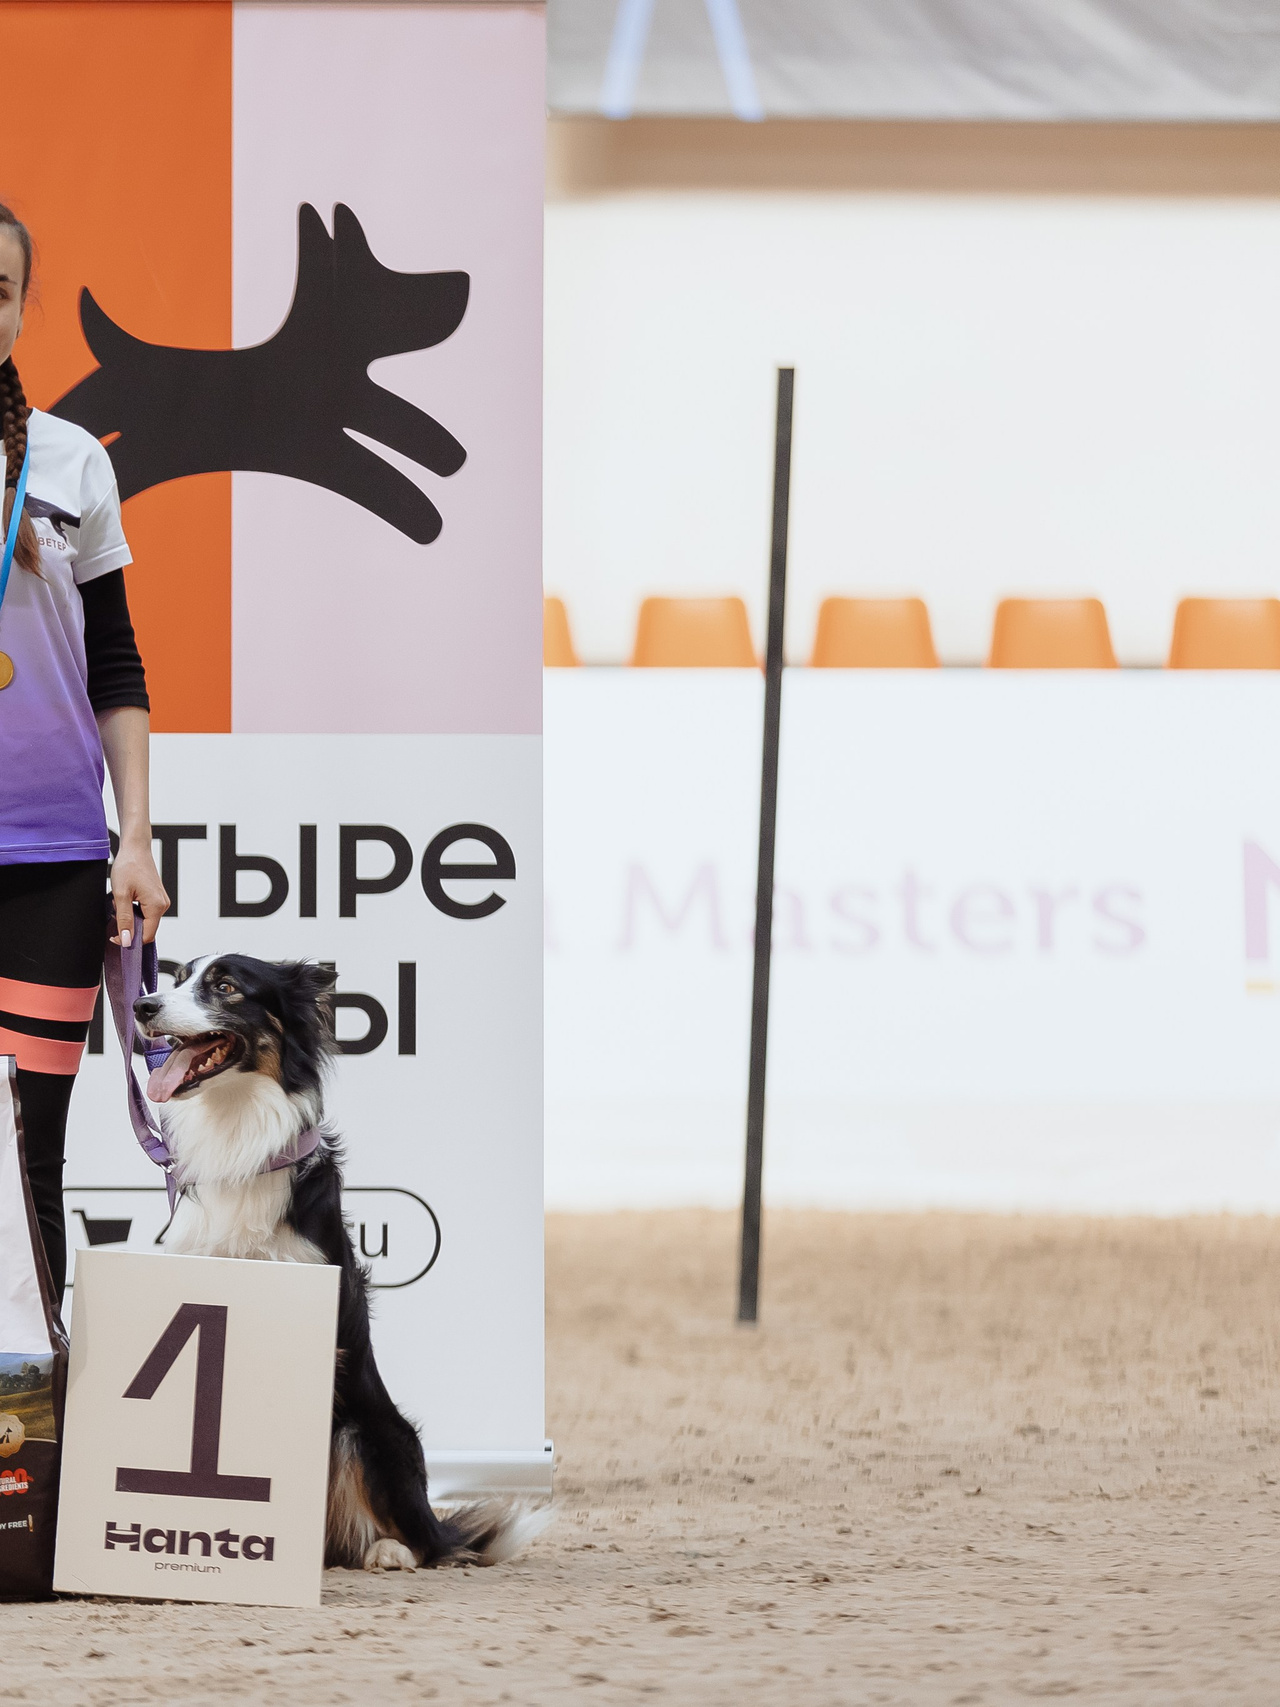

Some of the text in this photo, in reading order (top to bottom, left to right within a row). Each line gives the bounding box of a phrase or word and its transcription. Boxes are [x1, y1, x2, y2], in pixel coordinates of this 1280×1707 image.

[612, 856, 1152, 958] Masters
[115, 1302, 271, 1502] 1
[7, 1520, 28, 1529] FREE
[104, 1520, 275, 1561] Hanta
[154, 1562, 221, 1574] premium
